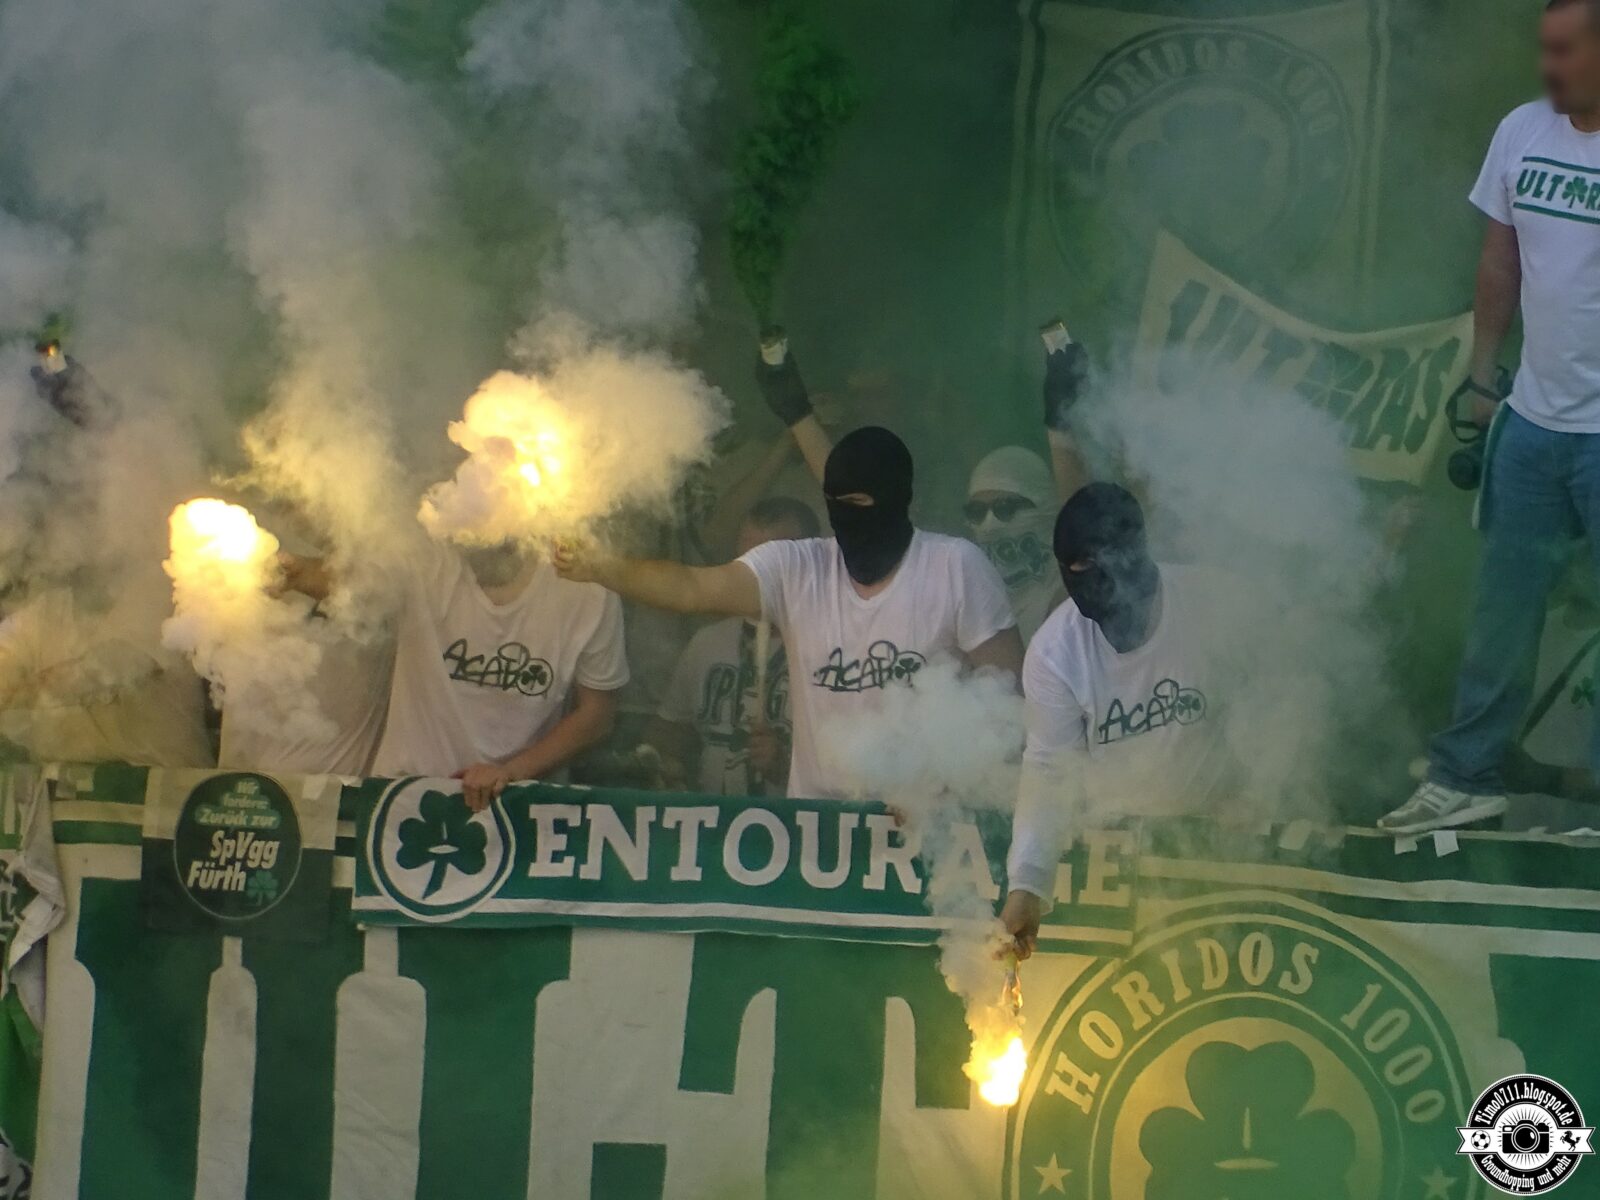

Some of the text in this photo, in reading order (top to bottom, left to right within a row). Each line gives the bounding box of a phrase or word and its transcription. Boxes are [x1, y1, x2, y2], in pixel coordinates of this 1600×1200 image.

[200, 808, 278, 827] Zurück zur
[210, 830, 280, 869] SpVgg
[528, 803, 1132, 908] ENTOURAE
[187, 860, 247, 892] Fürth
[1045, 930, 1447, 1123] HORIDOS 1000
